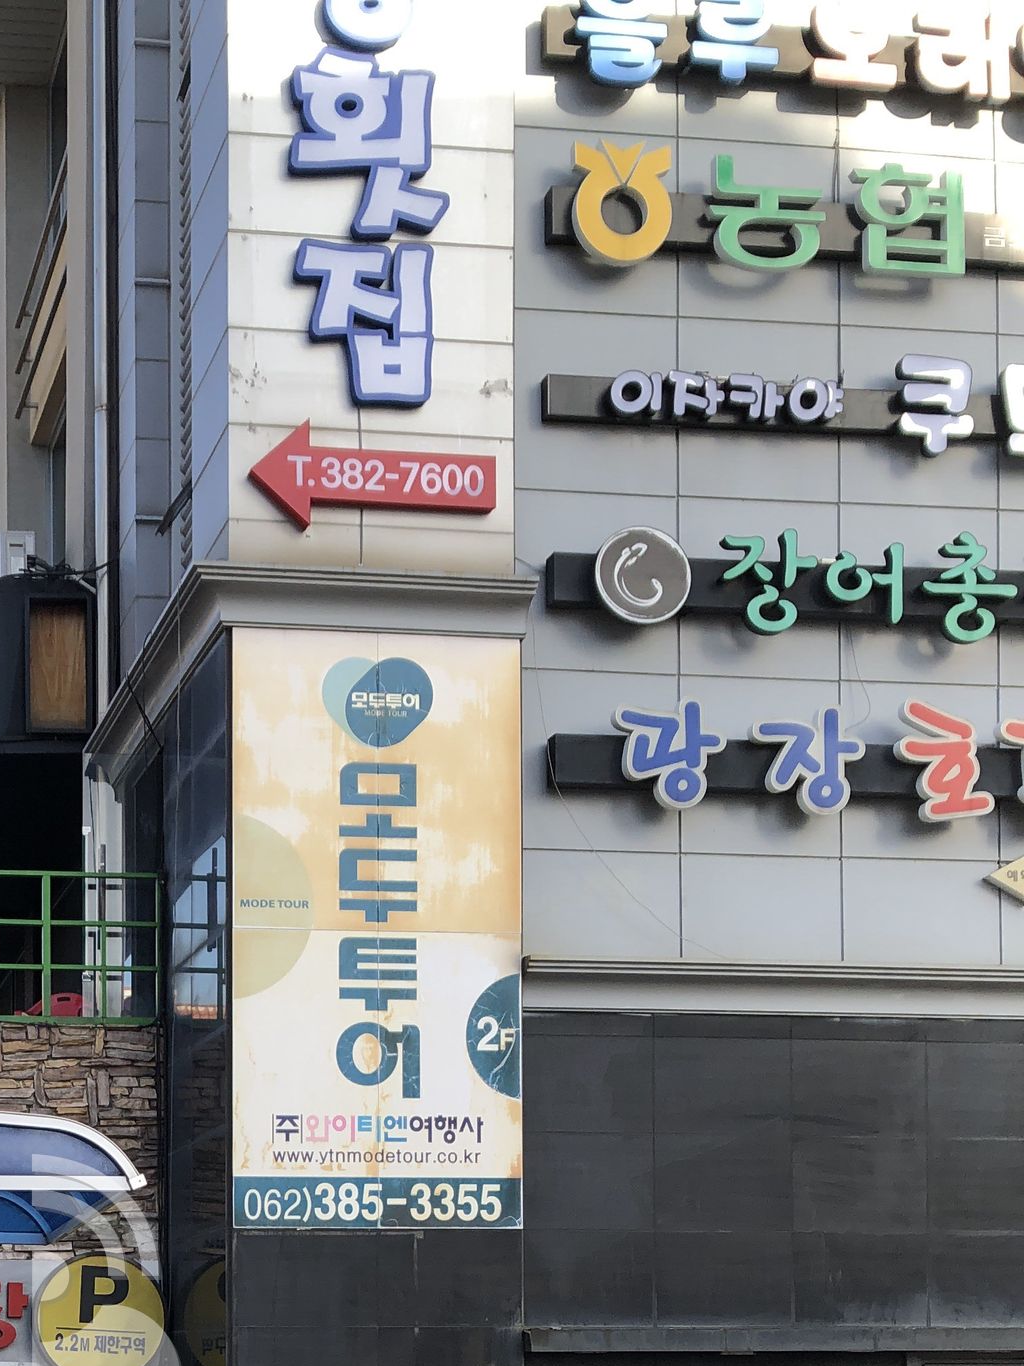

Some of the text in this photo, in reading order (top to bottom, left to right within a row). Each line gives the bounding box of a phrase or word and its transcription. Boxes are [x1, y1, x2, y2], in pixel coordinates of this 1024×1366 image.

[706, 153, 966, 277] 농협
[610, 353, 1024, 457] 이자카야 쿠
[351, 692, 420, 710] 모두투어
[388, 710, 408, 718] TOUR
[239, 898, 310, 910] MODE TOUR
[336, 762, 421, 1098] 모두투어
[476, 1017, 516, 1052] 2F
[273, 1148, 481, 1165] www.ytnmodetour.co.kr
[79, 1265, 130, 1324] P
[94, 1335, 146, 1355] 제한구역
